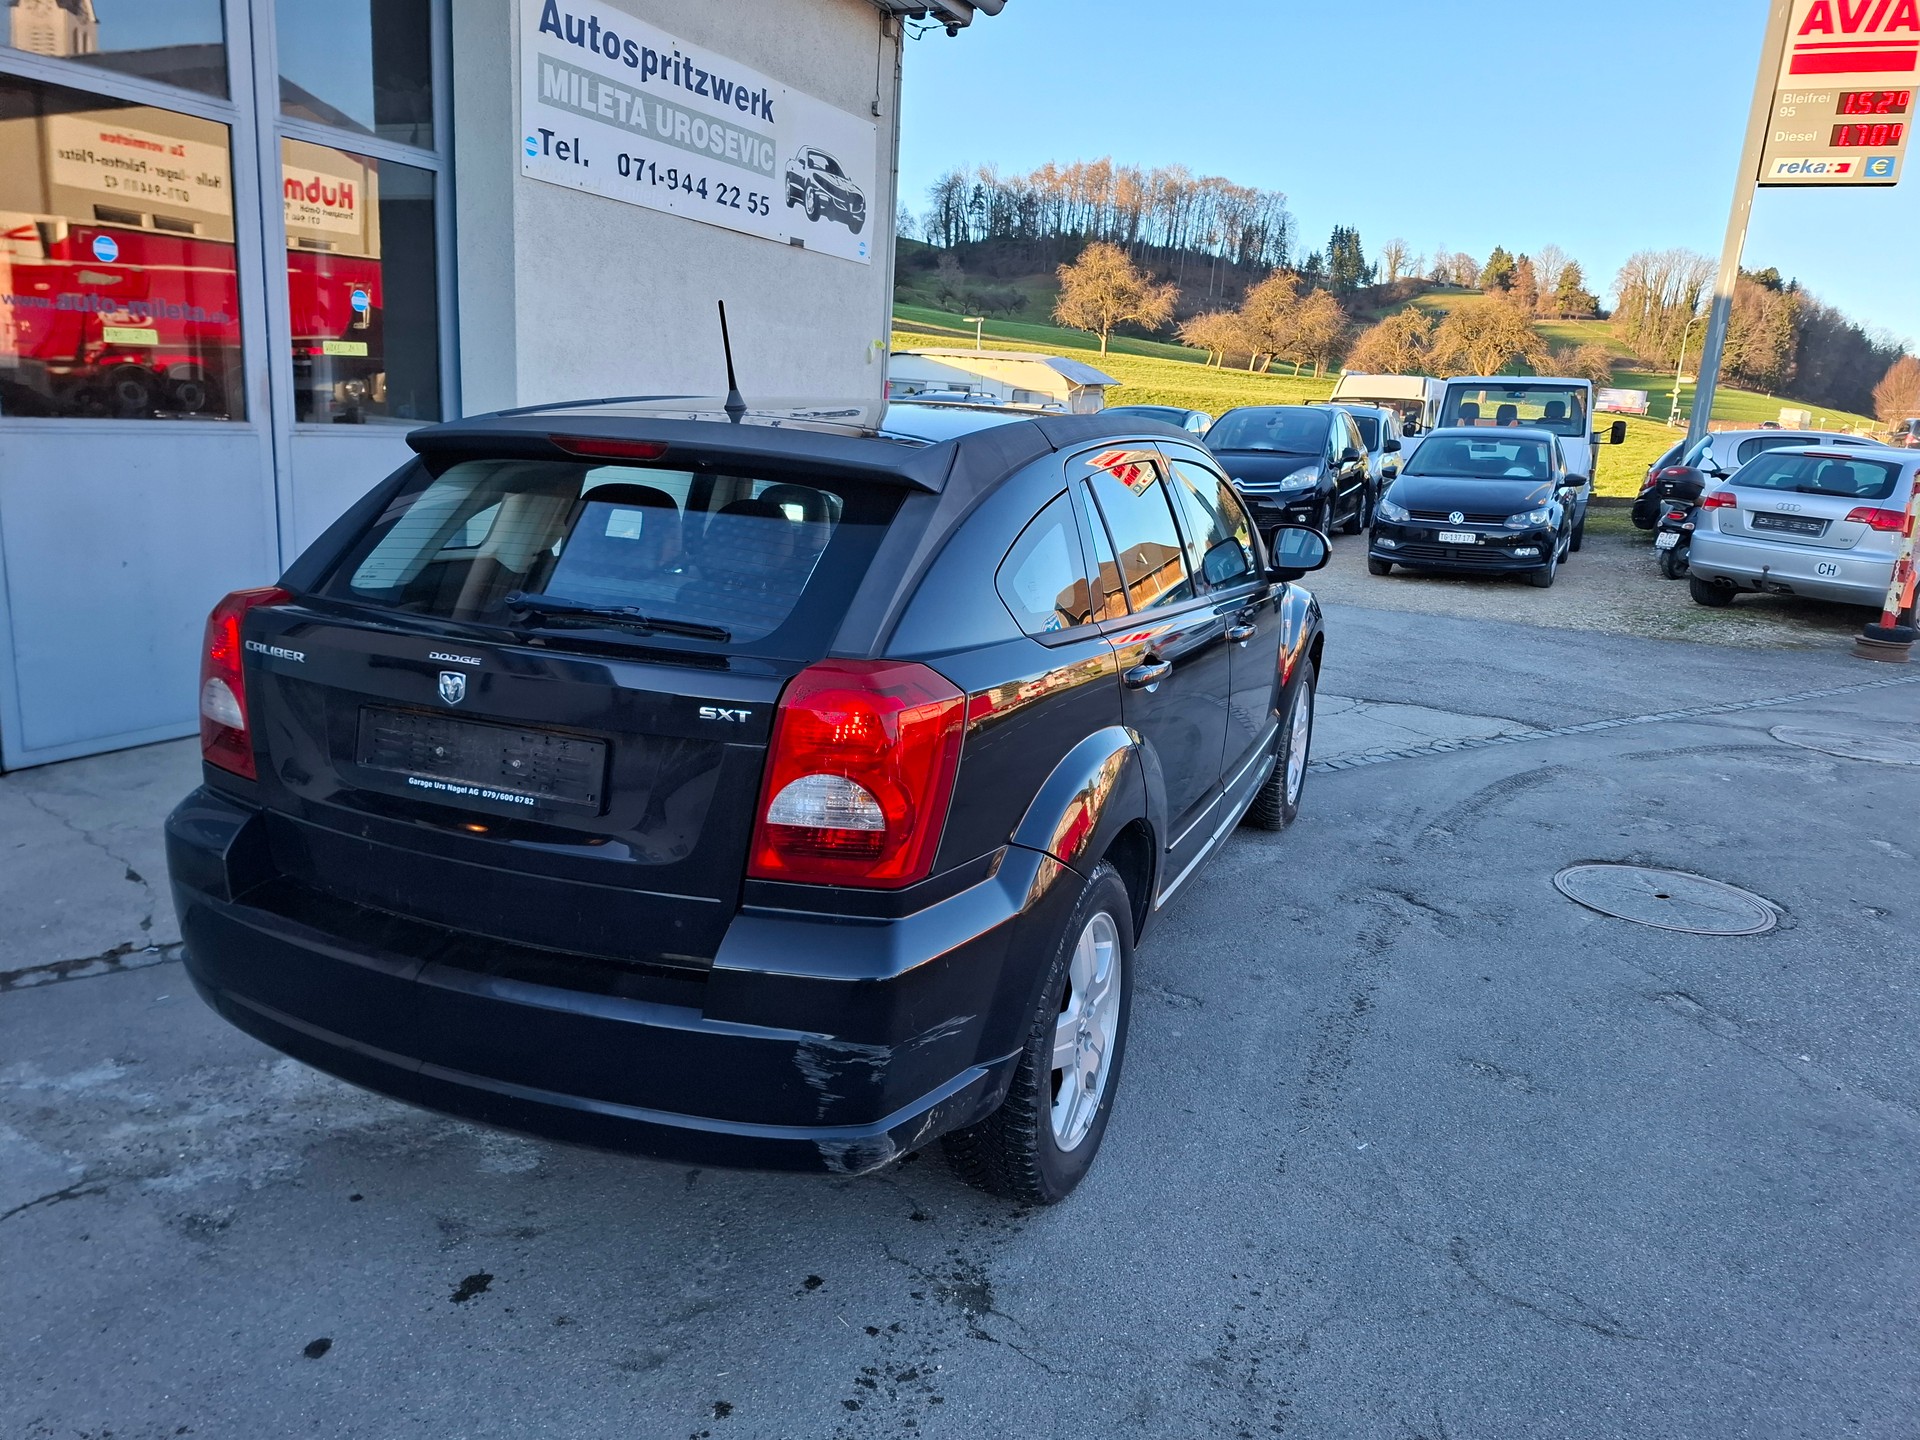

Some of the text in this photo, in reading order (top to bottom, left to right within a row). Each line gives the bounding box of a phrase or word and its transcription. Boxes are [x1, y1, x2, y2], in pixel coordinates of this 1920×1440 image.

[1797, 0, 1920, 36] AVIA
[539, 0, 775, 125] Autospritzwerk
[1782, 92, 1831, 104] Bleifrei
[543, 62, 775, 172] MILETA UROSEVIC
[1779, 106, 1796, 118] 95
[1774, 131, 1817, 143] Diesel
[538, 128, 589, 167] Tel.
[617, 152, 708, 199] 071-944
[715, 182, 741, 209] 22
[747, 192, 771, 217] 55
[1817, 562, 1837, 576] CH
[245, 640, 306, 664] CALIBER
[429, 651, 482, 666] DODGE
[699, 706, 752, 723] SXT
[408, 777, 433, 789] Garage
[434, 782, 446, 790] Urs
[447, 784, 467, 794] Nagel
[468, 788, 479, 796] AG
[482, 790, 514, 802] 079/600
